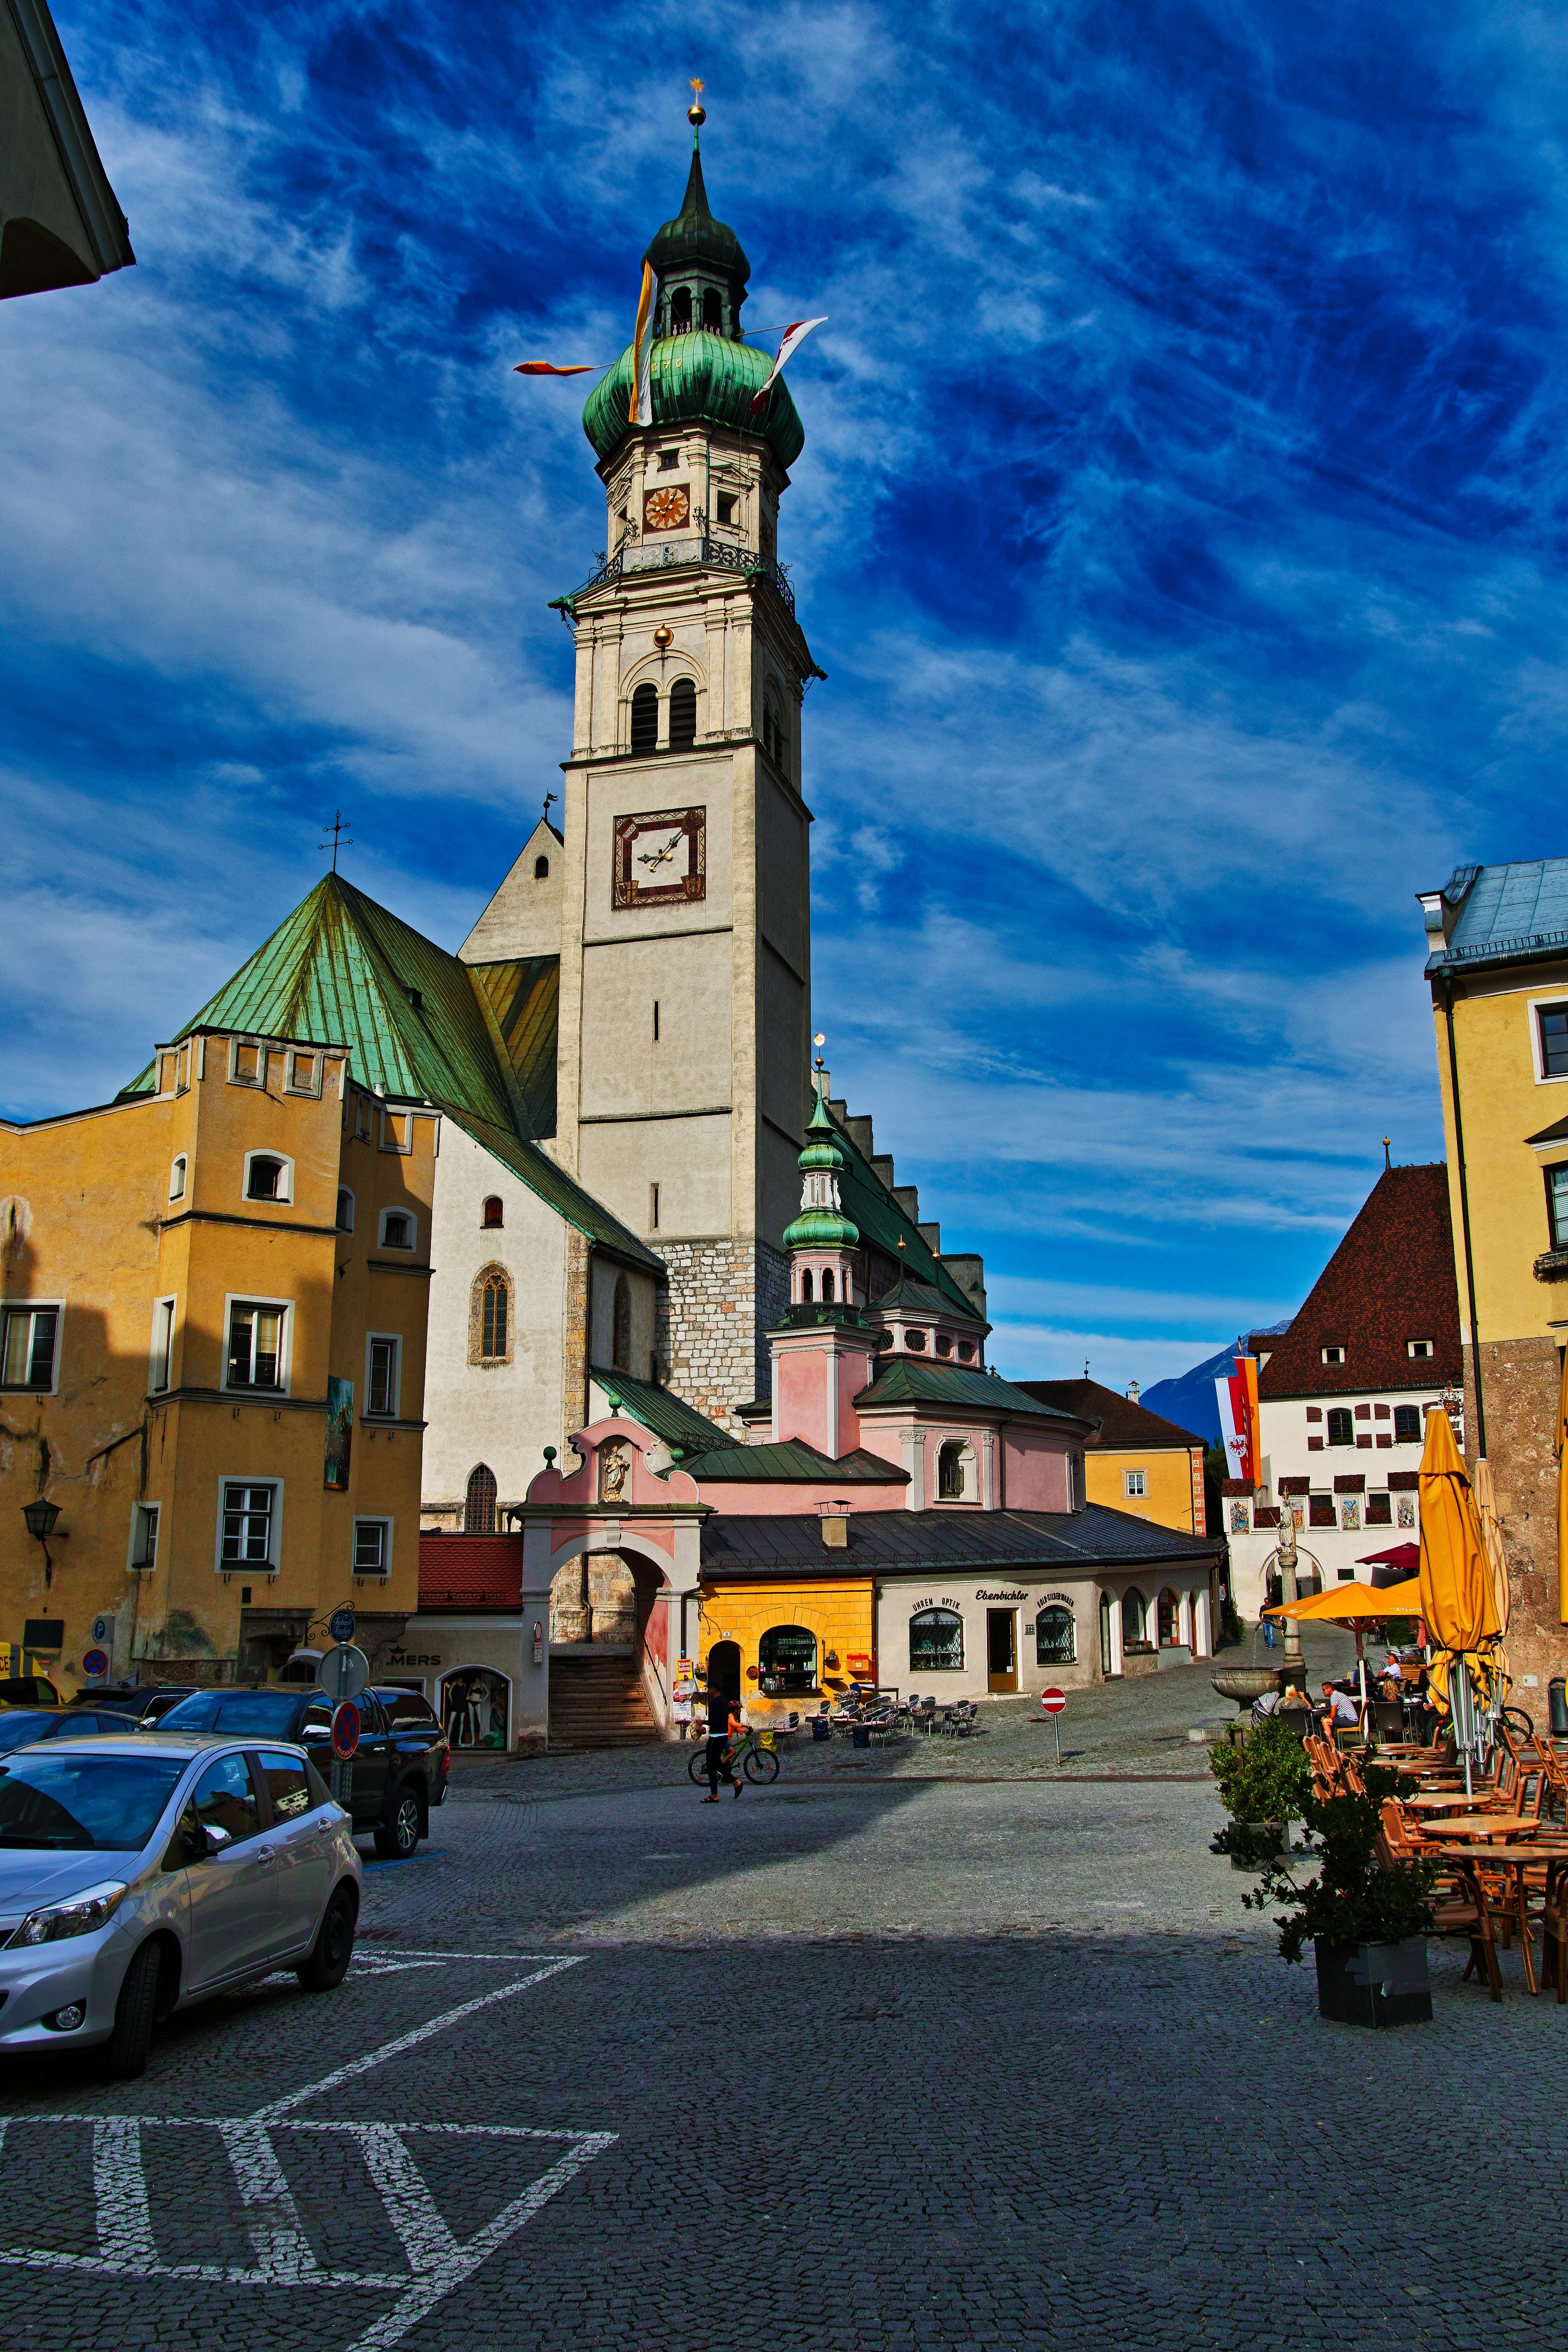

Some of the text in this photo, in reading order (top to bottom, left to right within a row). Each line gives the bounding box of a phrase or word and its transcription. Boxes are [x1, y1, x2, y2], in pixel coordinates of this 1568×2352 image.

[975, 1589, 1029, 1601] Ebenbichler
[912, 1597, 961, 1611] UHREN OPTIK
[333, 1615, 353, 1626] Tabak
[333, 1626, 353, 1638] Trafik
[337, 1746, 353, 1756] ANFANG
